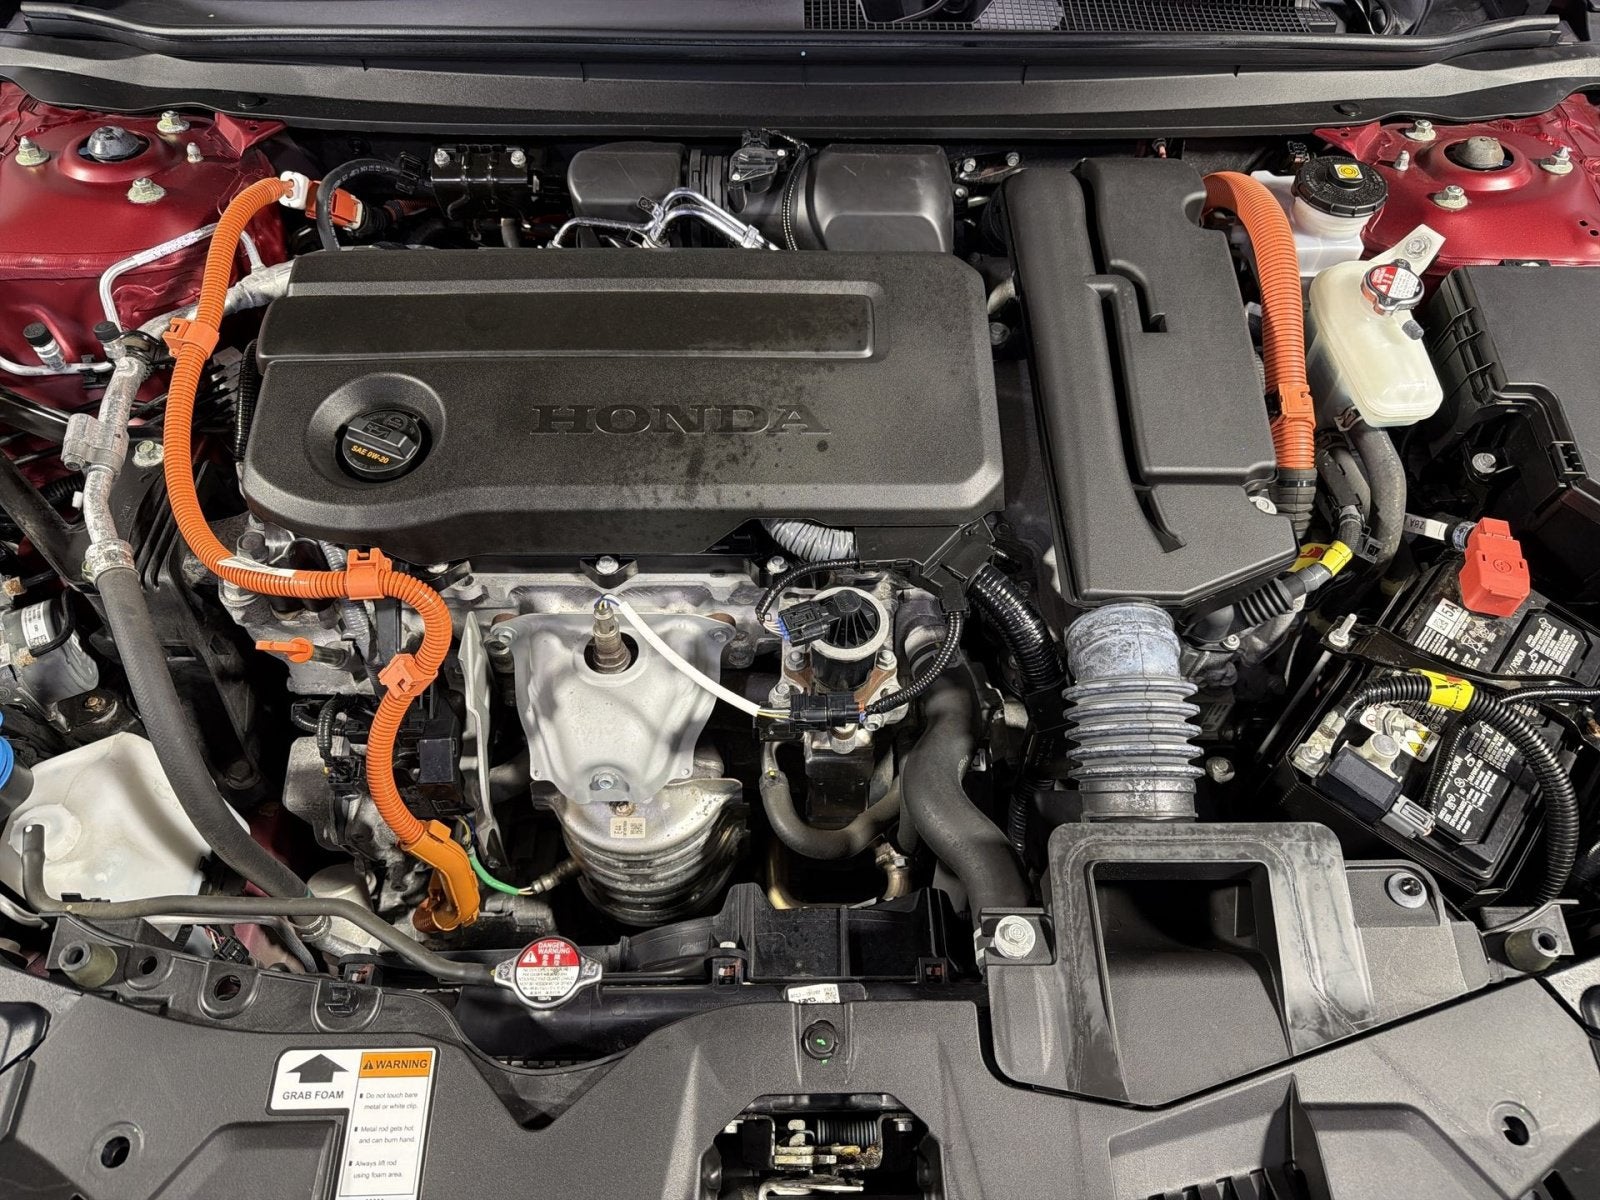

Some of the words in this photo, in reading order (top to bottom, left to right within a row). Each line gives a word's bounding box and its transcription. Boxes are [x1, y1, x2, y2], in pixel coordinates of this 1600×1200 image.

[529, 404, 832, 435] HONDA
[351, 445, 367, 456] SAE
[367, 451, 389, 464] 0W-20
[1444, 602, 1459, 618] 5A
[1511, 649, 1526, 667] POISON
[538, 941, 565, 949] DANGER
[375, 1059, 428, 1070] WARNING
[282, 1091, 312, 1100] GRAB
[314, 1090, 344, 1100] FOAM
[355, 1160, 376, 1168] Always
